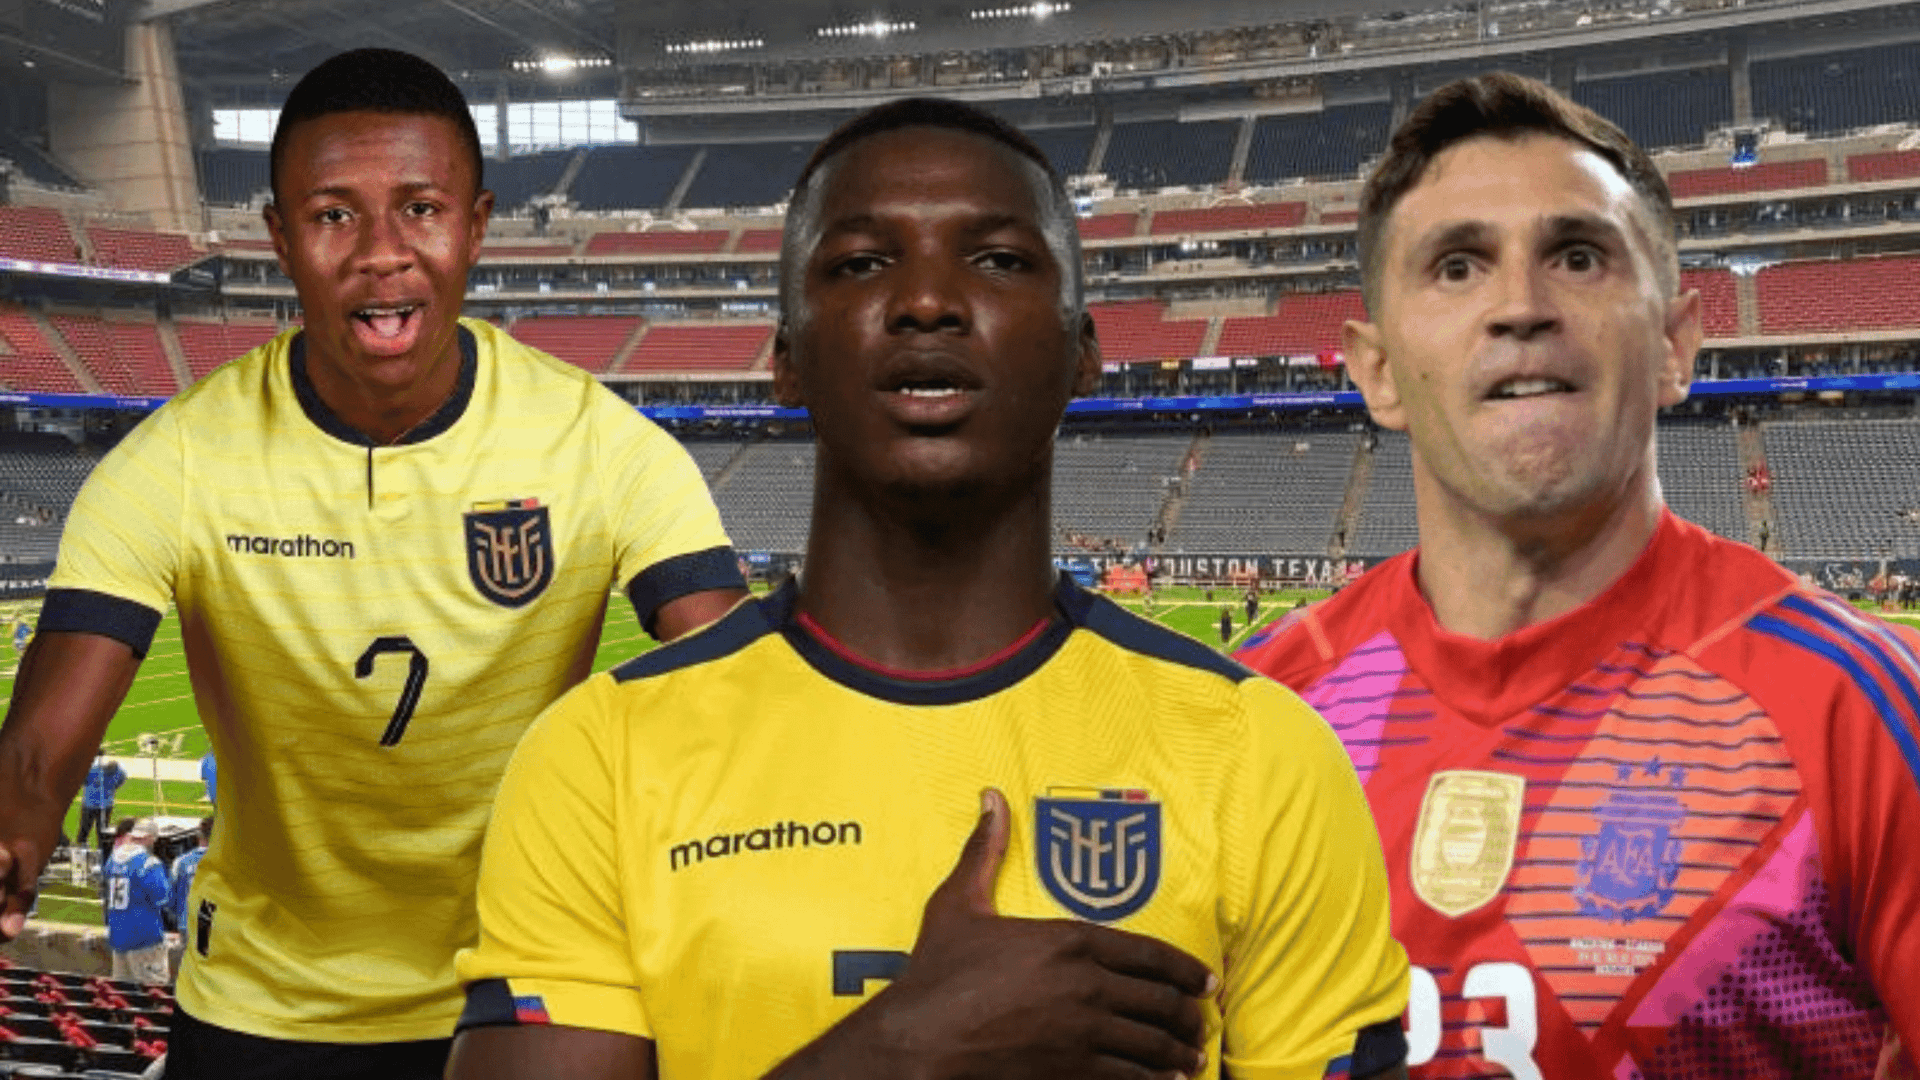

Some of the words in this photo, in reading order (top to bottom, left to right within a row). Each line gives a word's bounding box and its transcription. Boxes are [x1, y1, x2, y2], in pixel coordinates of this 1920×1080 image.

[226, 534, 354, 559] marathon
[354, 635, 429, 748] 7
[670, 820, 862, 872] marathon
[108, 877, 130, 910] 13
